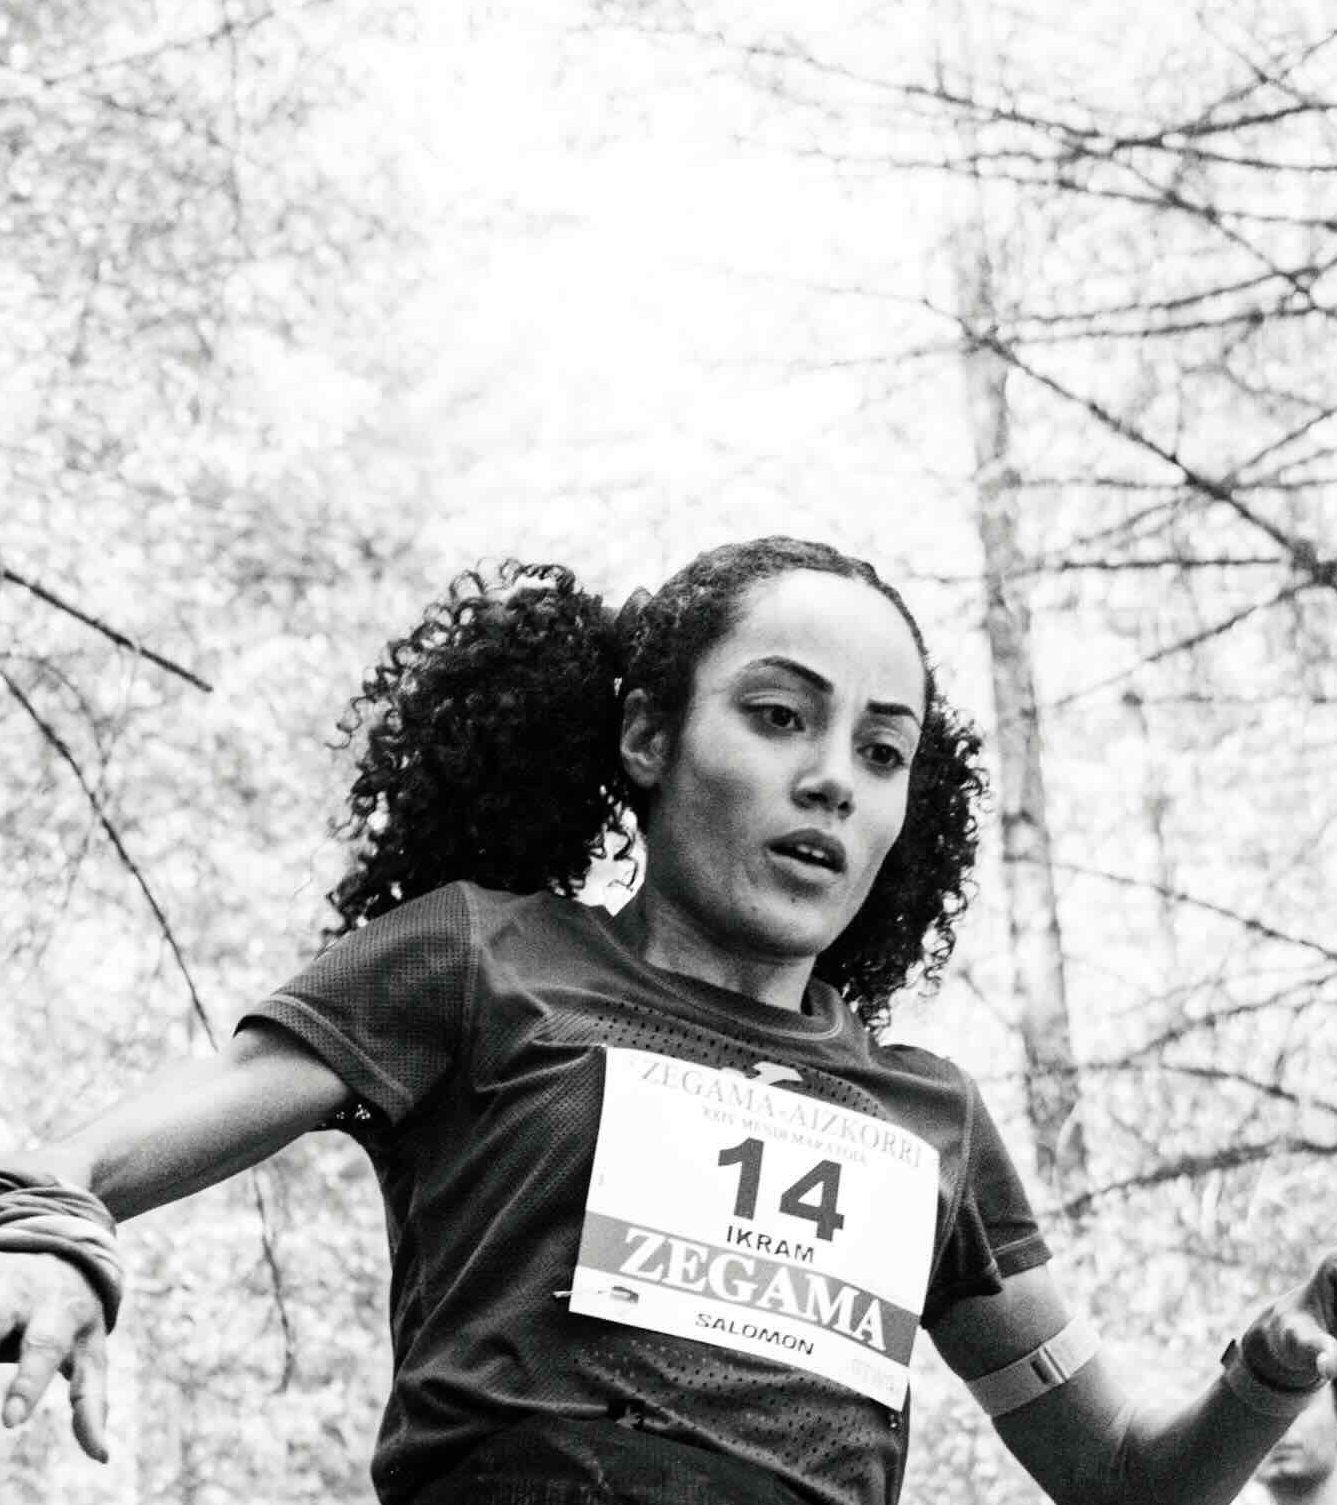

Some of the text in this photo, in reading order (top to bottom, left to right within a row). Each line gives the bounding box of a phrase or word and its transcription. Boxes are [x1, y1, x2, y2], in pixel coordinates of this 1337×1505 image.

[717, 1137, 845, 1242] 14
[726, 1225, 815, 1264] IKRAM
[619, 1227, 887, 1351] ZEGAMA
[695, 1312, 815, 1356] SALOMON
